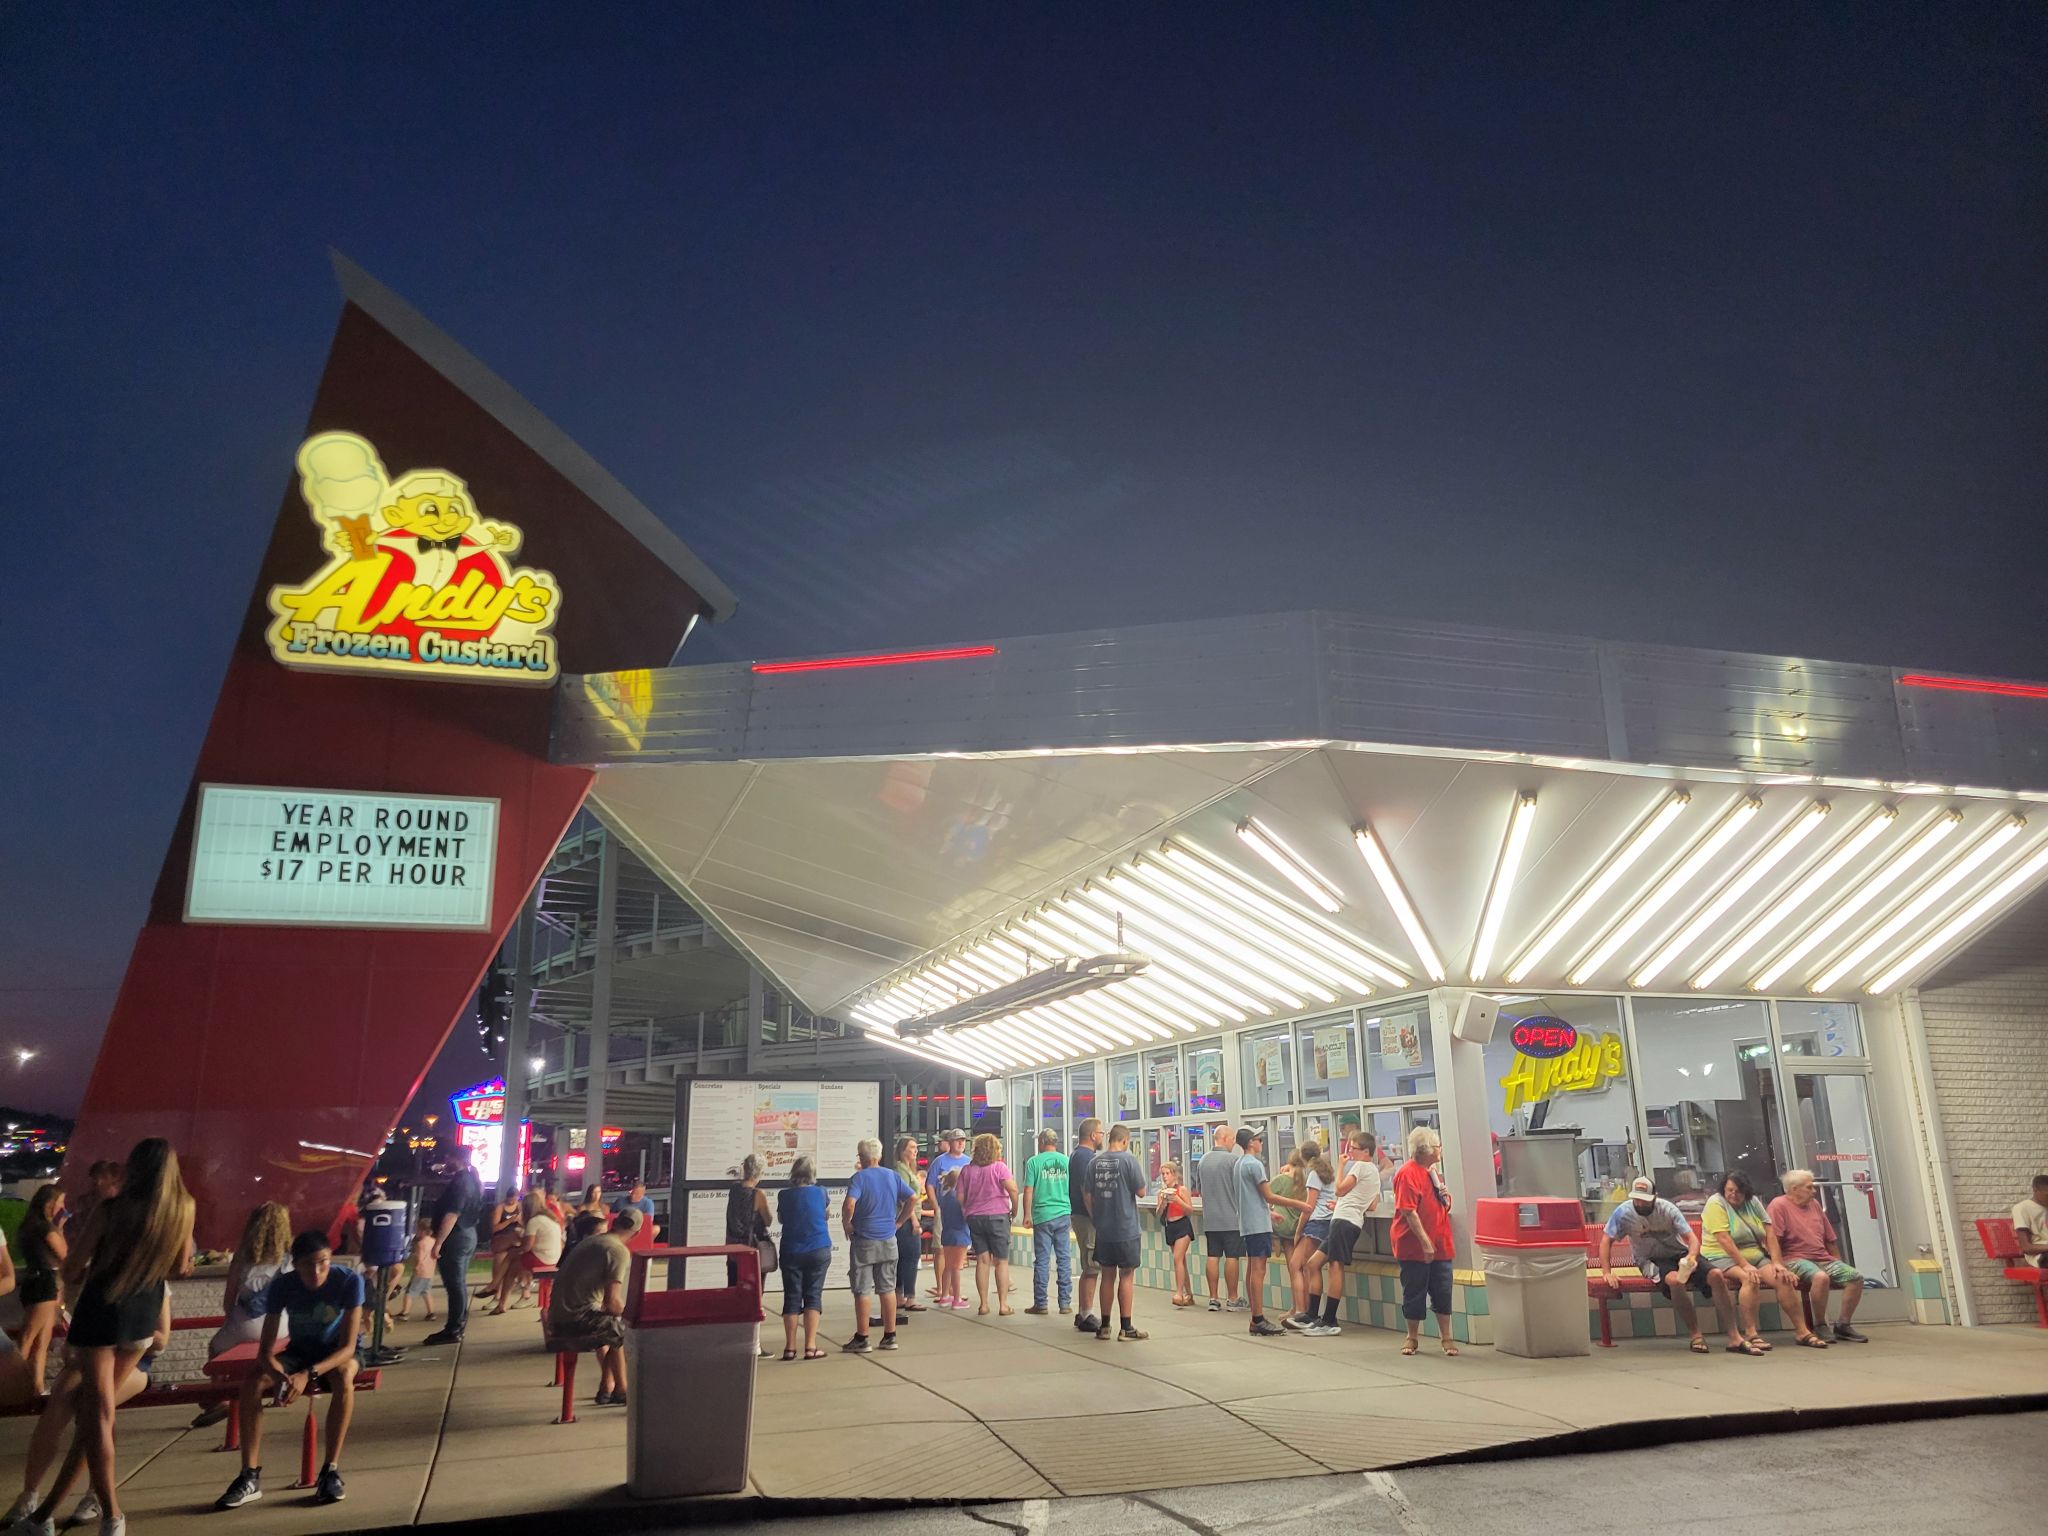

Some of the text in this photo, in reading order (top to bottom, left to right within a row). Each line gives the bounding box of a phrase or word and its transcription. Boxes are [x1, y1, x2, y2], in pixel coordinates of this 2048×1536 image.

[280, 552, 552, 636] Andy's
[287, 622, 549, 671] Frozen Custard
[283, 803, 469, 832] YEAR ROUND
[272, 831, 466, 859] EMPLOYMENT
[260, 858, 466, 887] $17 PER HOUR
[1513, 1027, 1575, 1047] OPEN
